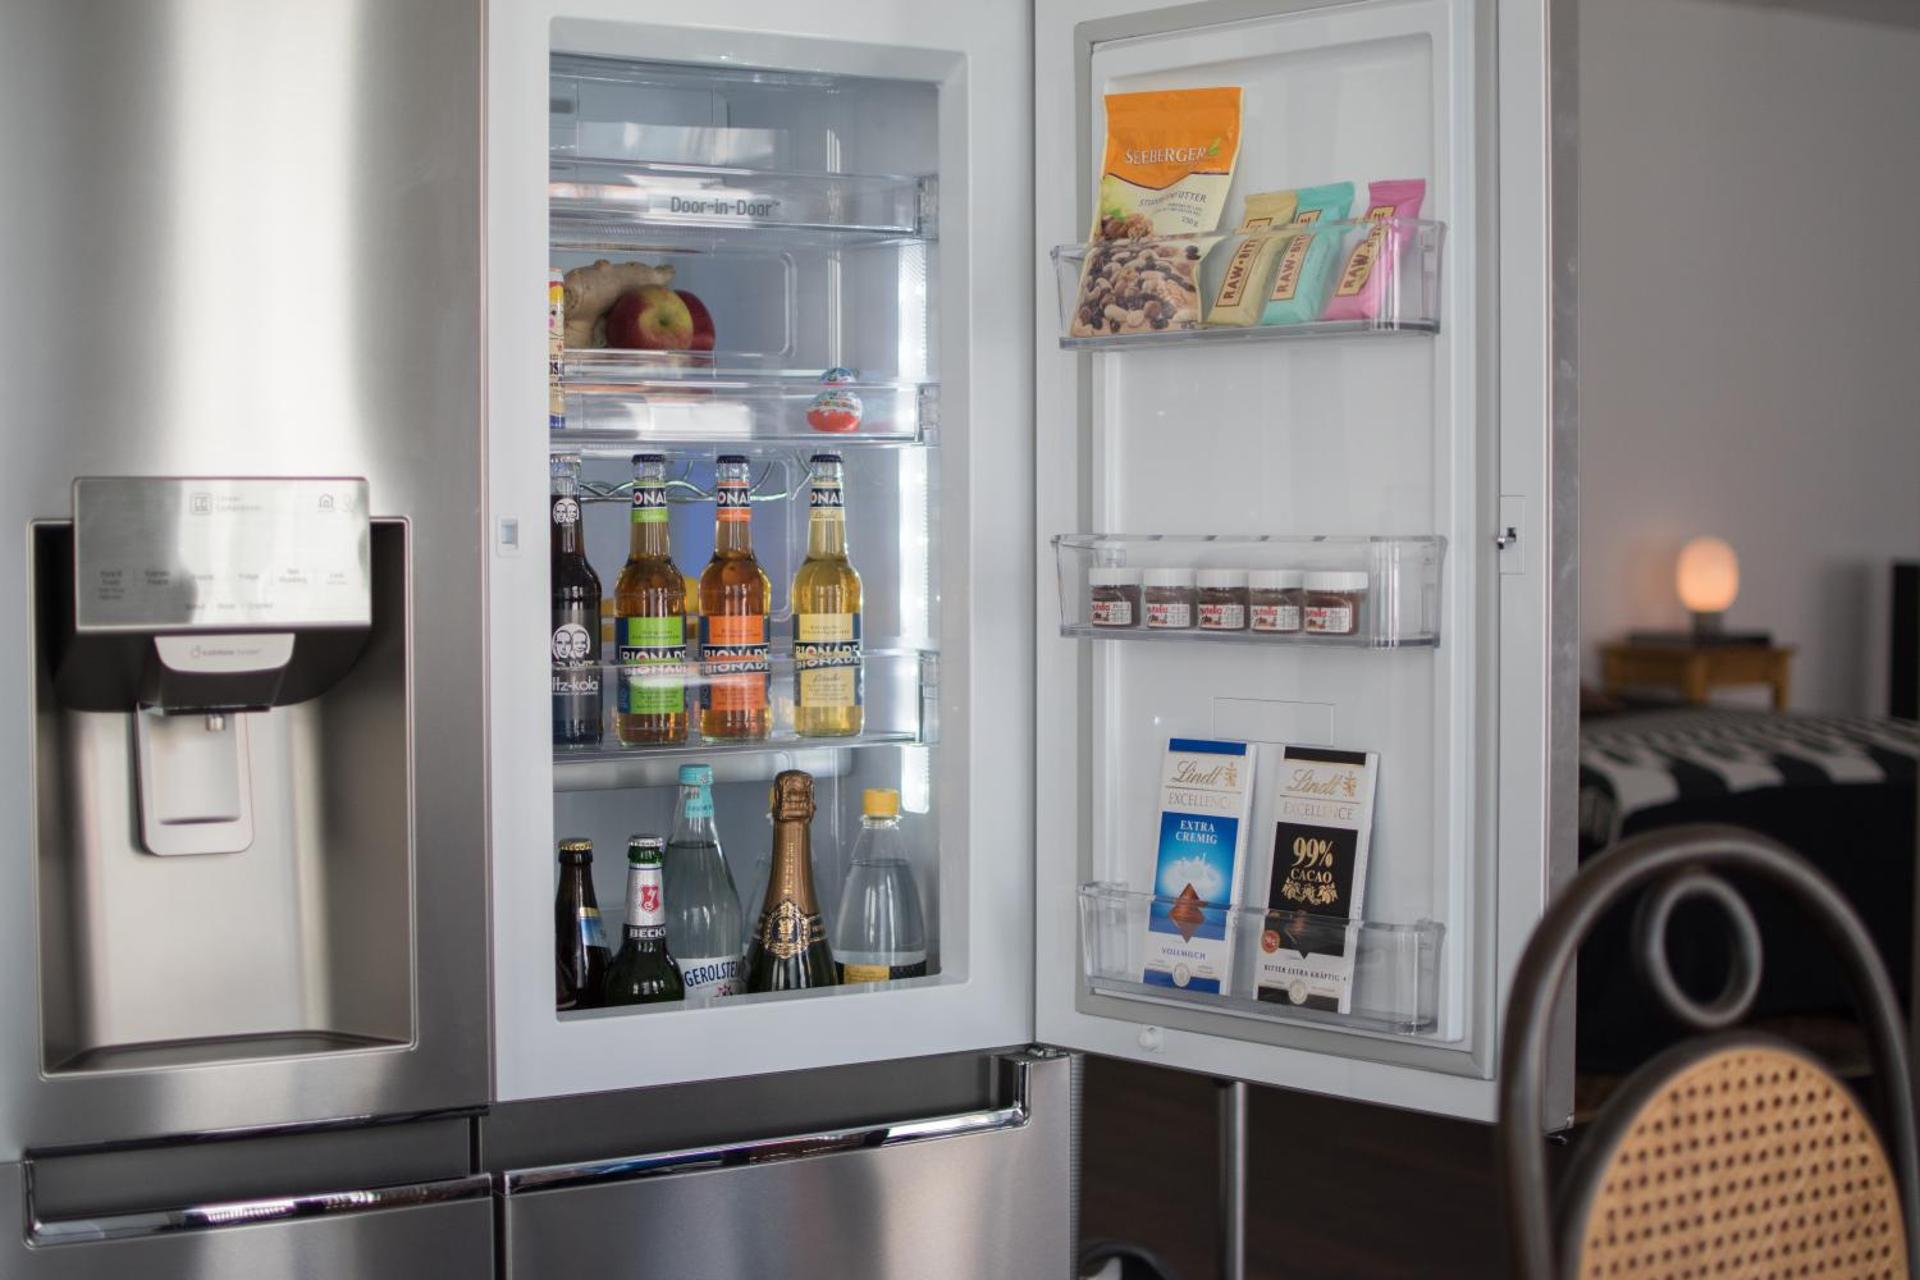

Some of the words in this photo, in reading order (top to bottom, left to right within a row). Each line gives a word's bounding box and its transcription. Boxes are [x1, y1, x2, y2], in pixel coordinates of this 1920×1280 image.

[1223, 265, 1245, 299] RAW
[1171, 760, 1224, 785] Lindt
[1285, 768, 1342, 796] Lindt
[1175, 831, 1219, 845] CREMIG
[1180, 819, 1215, 833] EXTRA
[1290, 836, 1334, 868] 99%
[1290, 869, 1333, 884] CACAO
